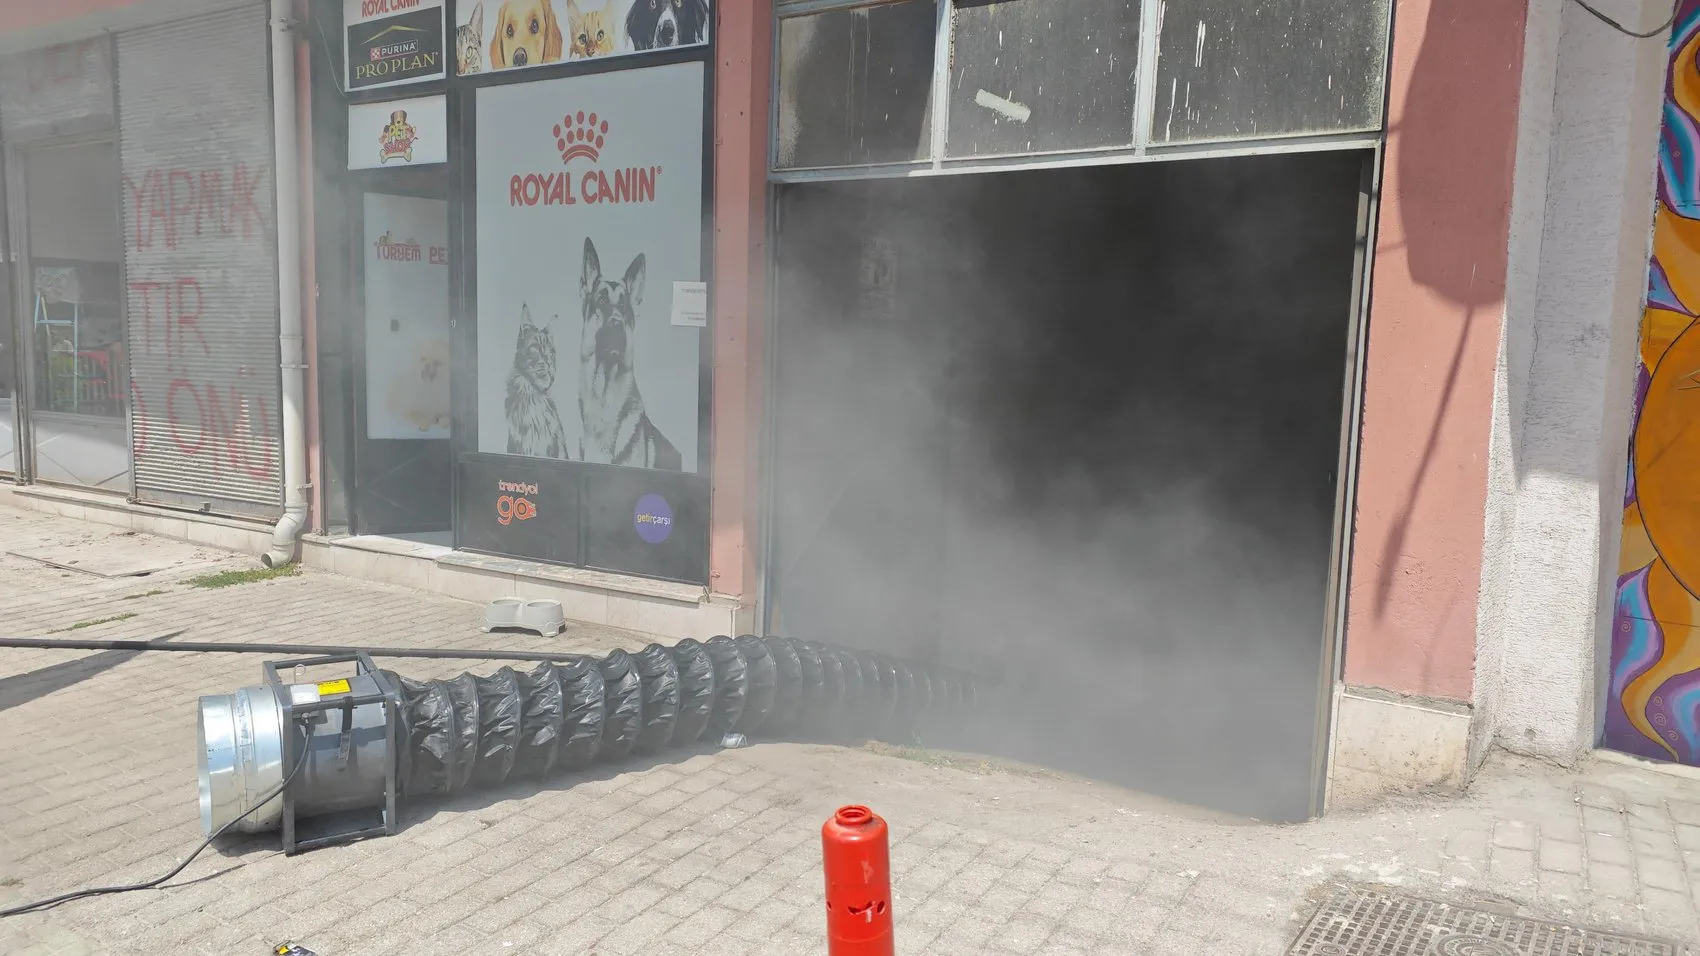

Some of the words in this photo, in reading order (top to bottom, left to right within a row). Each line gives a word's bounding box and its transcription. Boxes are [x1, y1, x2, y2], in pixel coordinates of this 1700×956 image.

[361, 0, 389, 18] ROYAL
[381, 43, 417, 56] PURINA
[355, 61, 389, 80] PRO
[510, 171, 577, 207] ROYAL
[498, 480, 538, 496] trendyol
[497, 495, 537, 526] go
